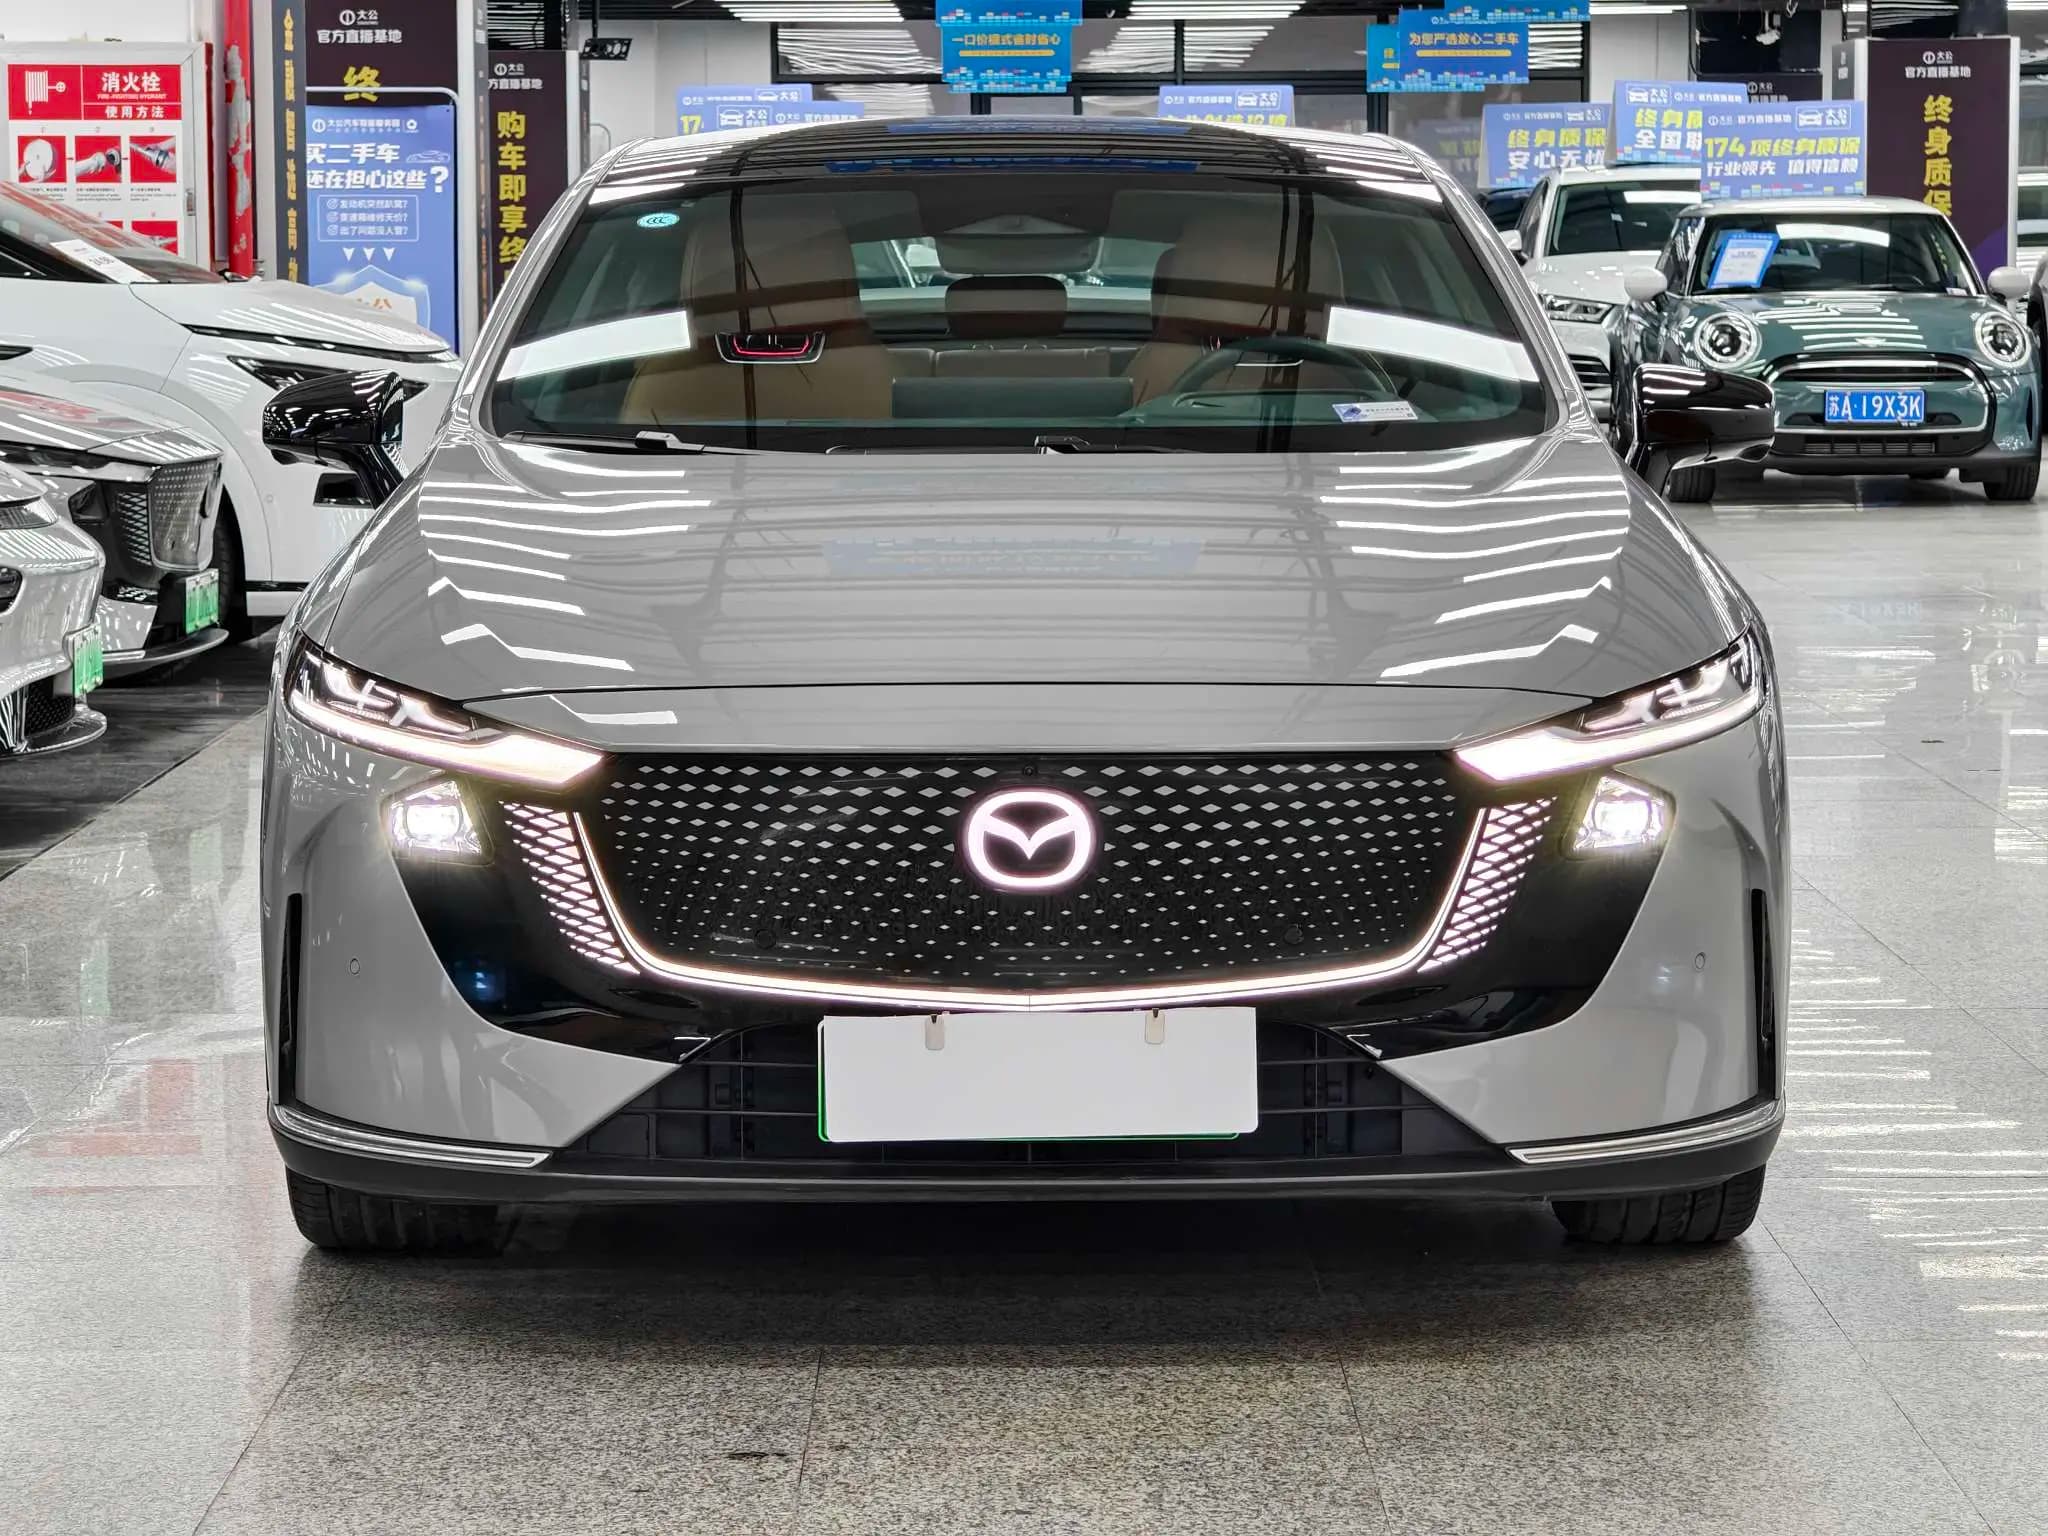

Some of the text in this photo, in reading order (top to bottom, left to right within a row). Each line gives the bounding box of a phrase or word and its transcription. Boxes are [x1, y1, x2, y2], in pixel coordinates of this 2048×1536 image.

[357, 10, 378, 20] 大公
[317, 29, 402, 43] 官方直播基地
[1409, 32, 1519, 46] 为您严选放心二手车
[1905, 66, 1971, 78] 官方直播基地
[101, 71, 161, 93] 消火栓
[105, 105, 165, 119] 使用方法
[746, 108, 768, 120] 大公
[1508, 127, 1606, 148] 终身质保
[306, 143, 401, 164] 买二手车
[1508, 150, 1606, 170] 安心无忧
[1706, 158, 1859, 177] 行业领先 值得信赖
